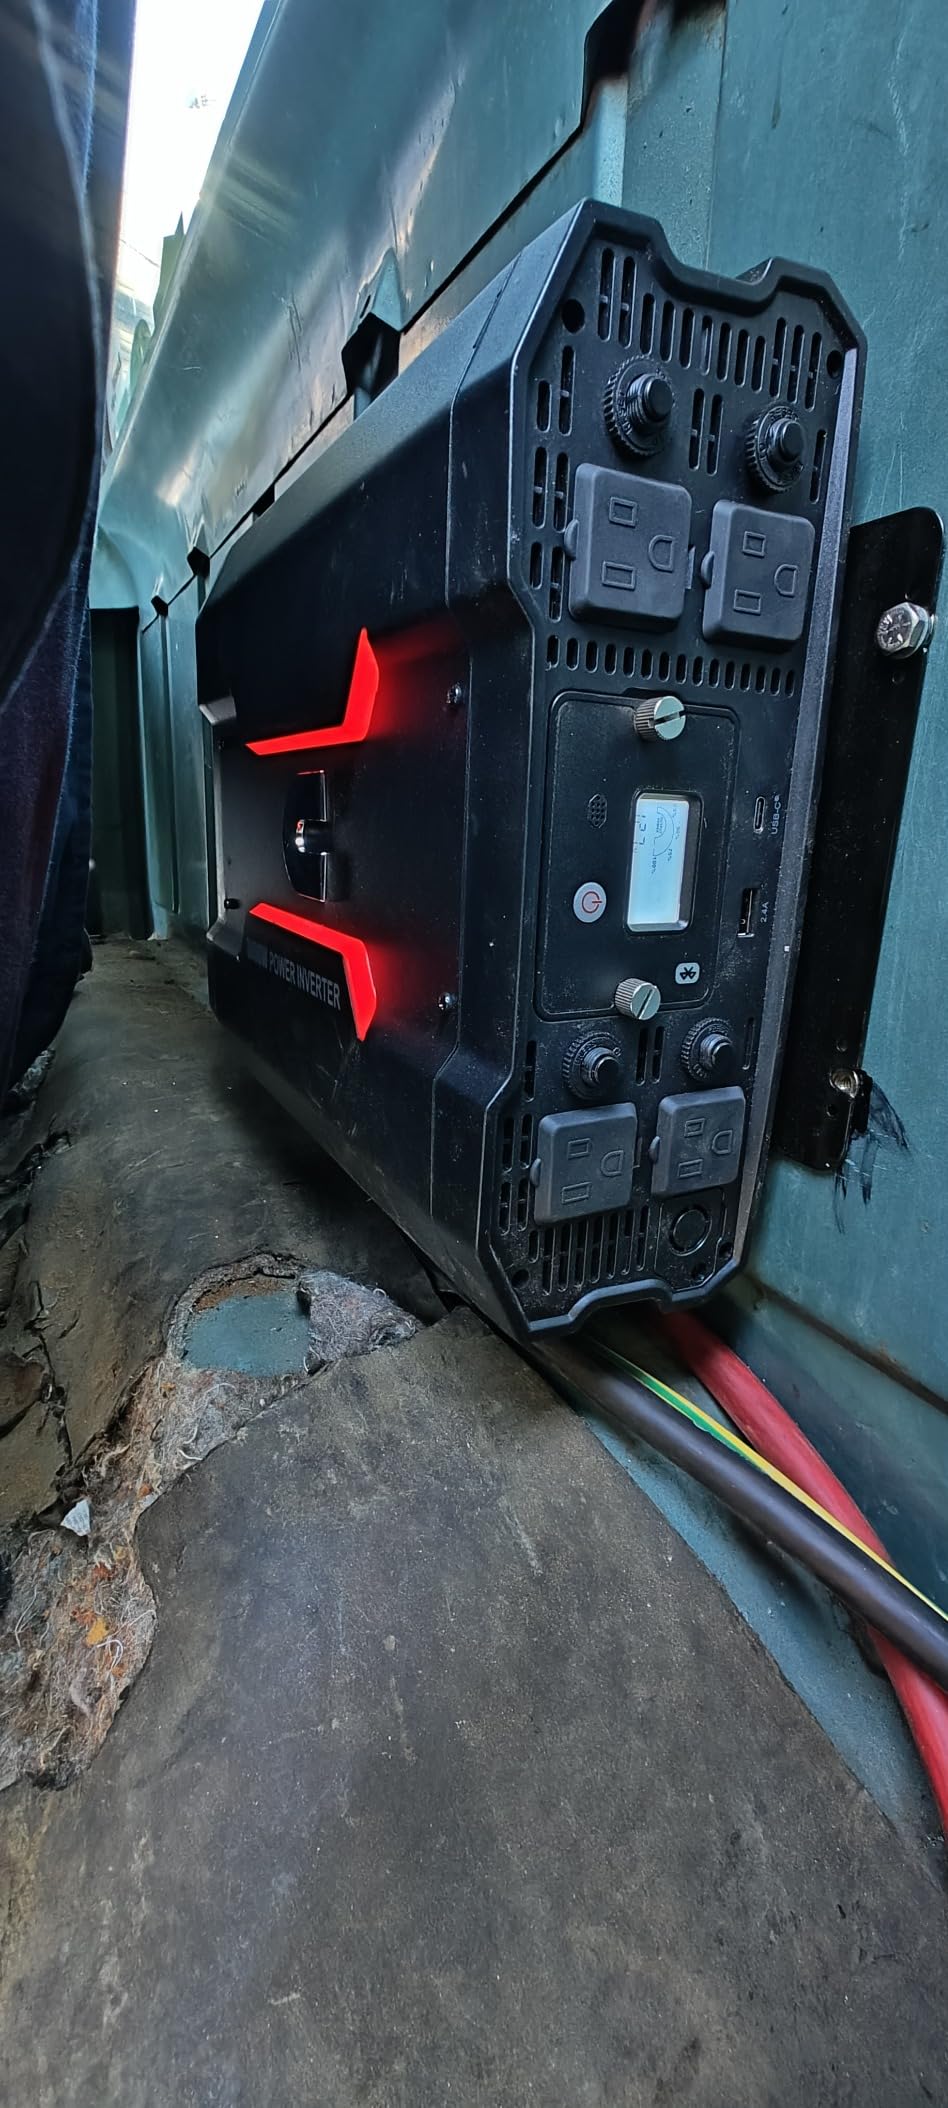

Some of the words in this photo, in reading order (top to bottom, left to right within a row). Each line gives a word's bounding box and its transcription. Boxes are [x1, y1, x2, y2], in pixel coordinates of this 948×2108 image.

[760, 901, 769, 923] 2.4A
[269, 951, 296, 985] POWER
[297, 964, 341, 1011] INVERTER
